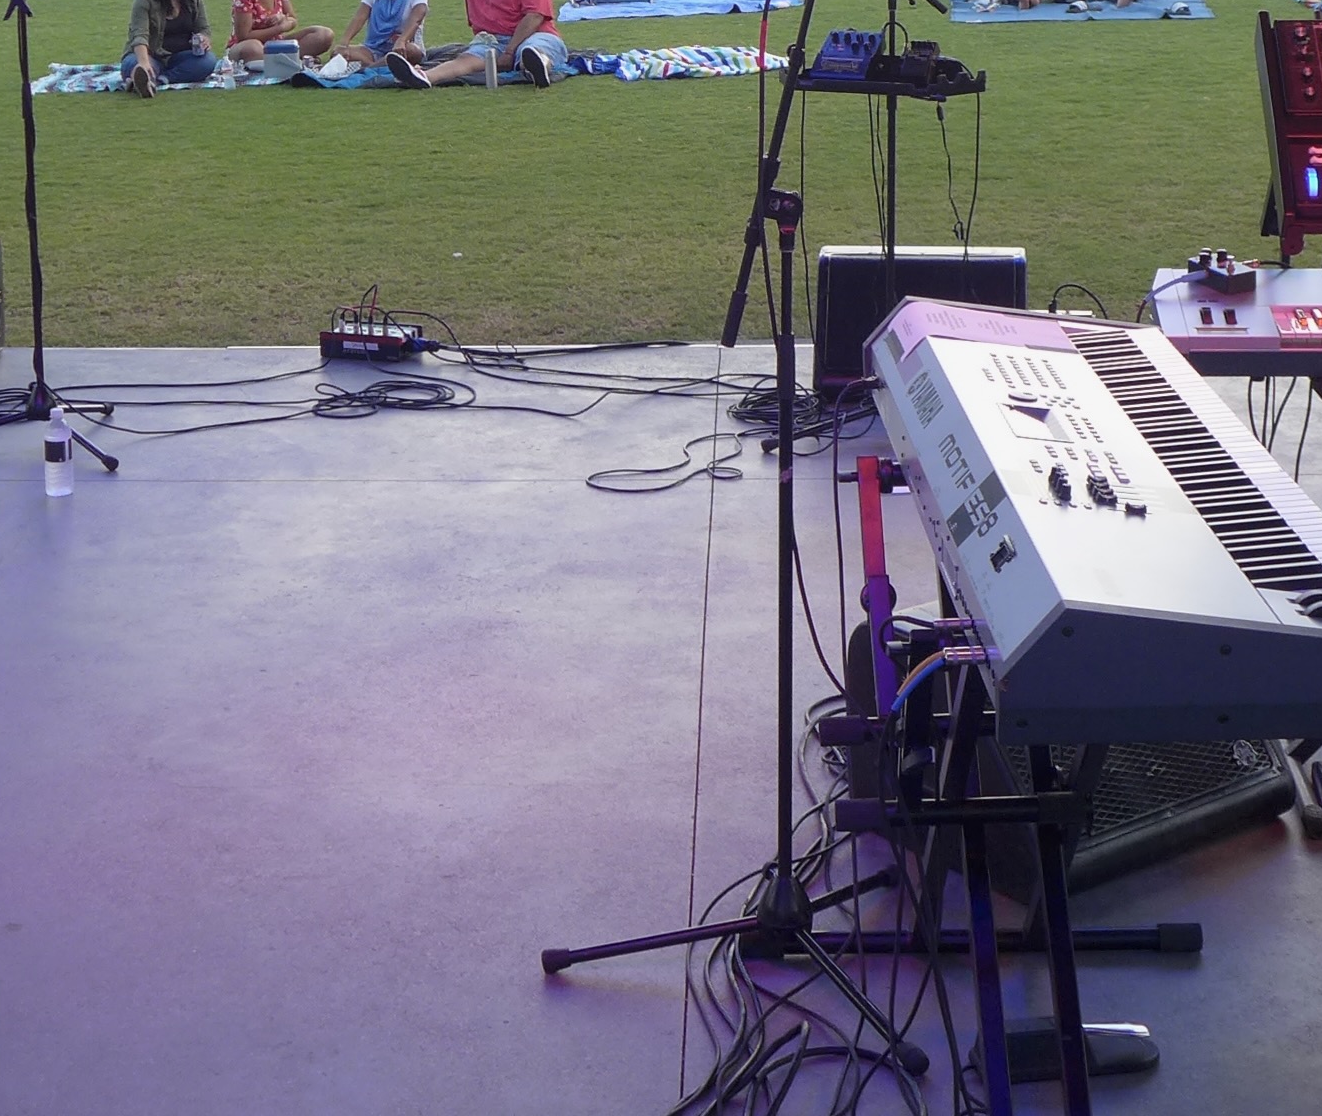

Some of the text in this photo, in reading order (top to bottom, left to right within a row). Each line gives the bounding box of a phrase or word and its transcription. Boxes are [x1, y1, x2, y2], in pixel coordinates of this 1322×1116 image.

[909, 376, 945, 430] YAMAHA
[938, 434, 999, 538] MOTIF ES8
